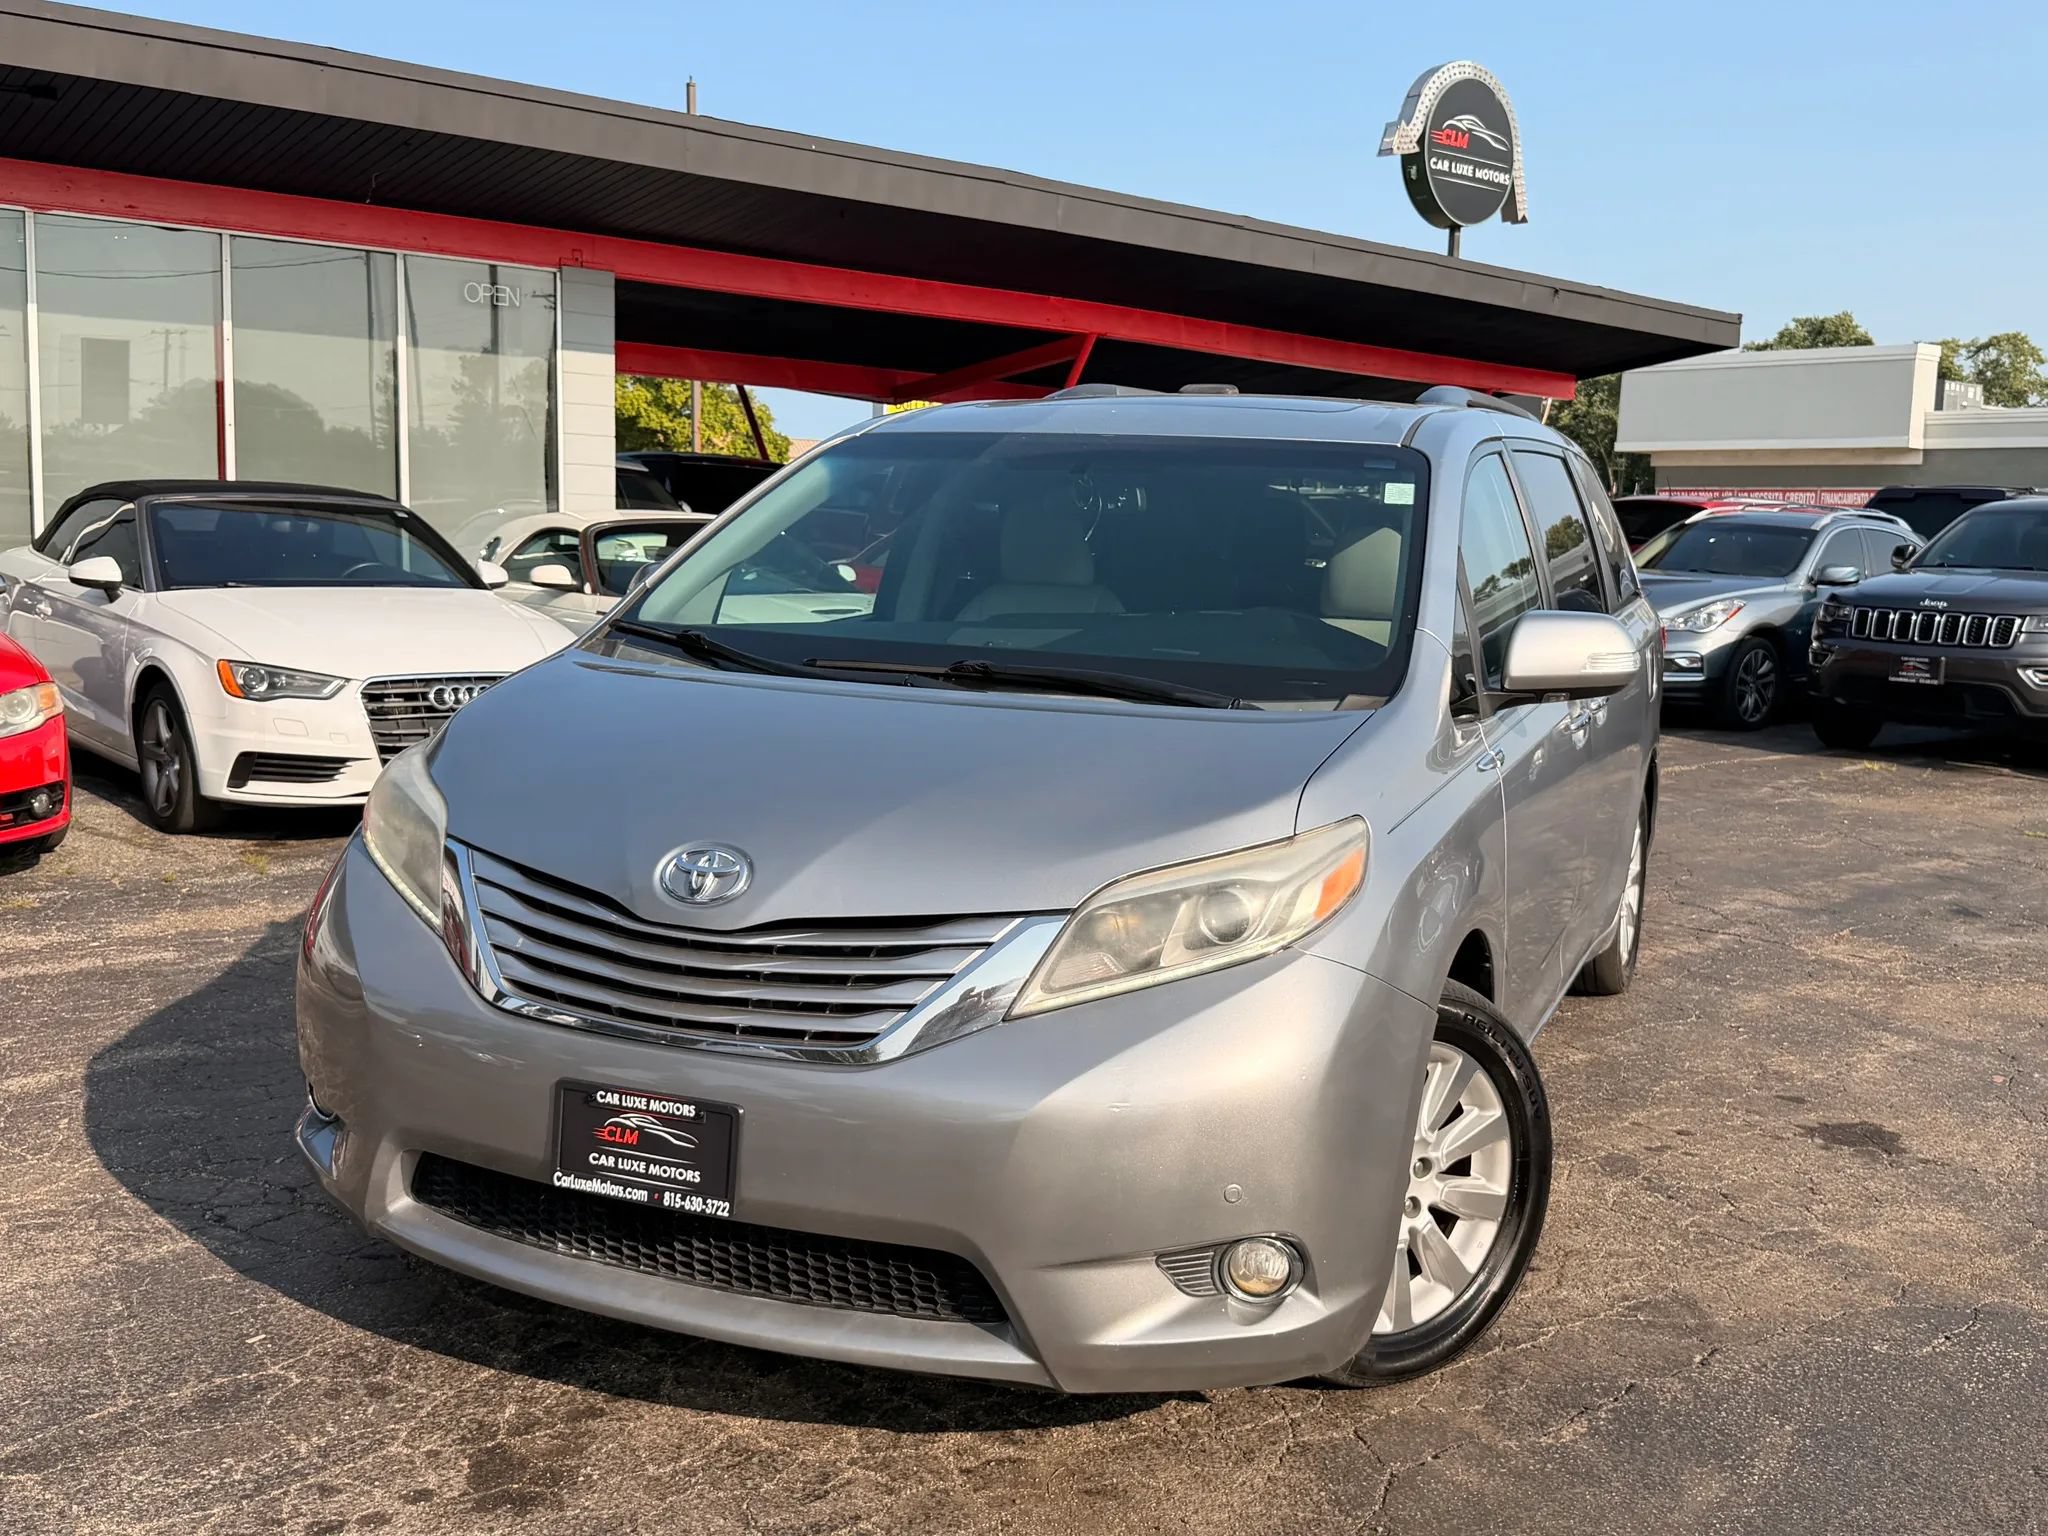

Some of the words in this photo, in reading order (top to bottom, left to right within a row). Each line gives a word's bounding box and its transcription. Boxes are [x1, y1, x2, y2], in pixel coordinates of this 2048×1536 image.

[1442, 129, 1470, 148] CLM
[1430, 157, 1449, 172] CAR
[1451, 161, 1474, 177] LUXE
[1475, 168, 1511, 186] MOTORS
[464, 282, 520, 307] OPEN
[1784, 492, 1816, 505] CREDITO
[596, 1090, 620, 1105] CAR
[622, 1094, 647, 1110] LUXE
[649, 1099, 696, 1117] MOTORS
[603, 1125, 640, 1145] CLM
[588, 1152, 615, 1168] CAR
[618, 1157, 646, 1173] LUXE
[648, 1163, 701, 1183] MOTORS
[553, 1171, 648, 1202] CarLuxeMotors.com
[663, 1191, 730, 1217] 815-630-3722
